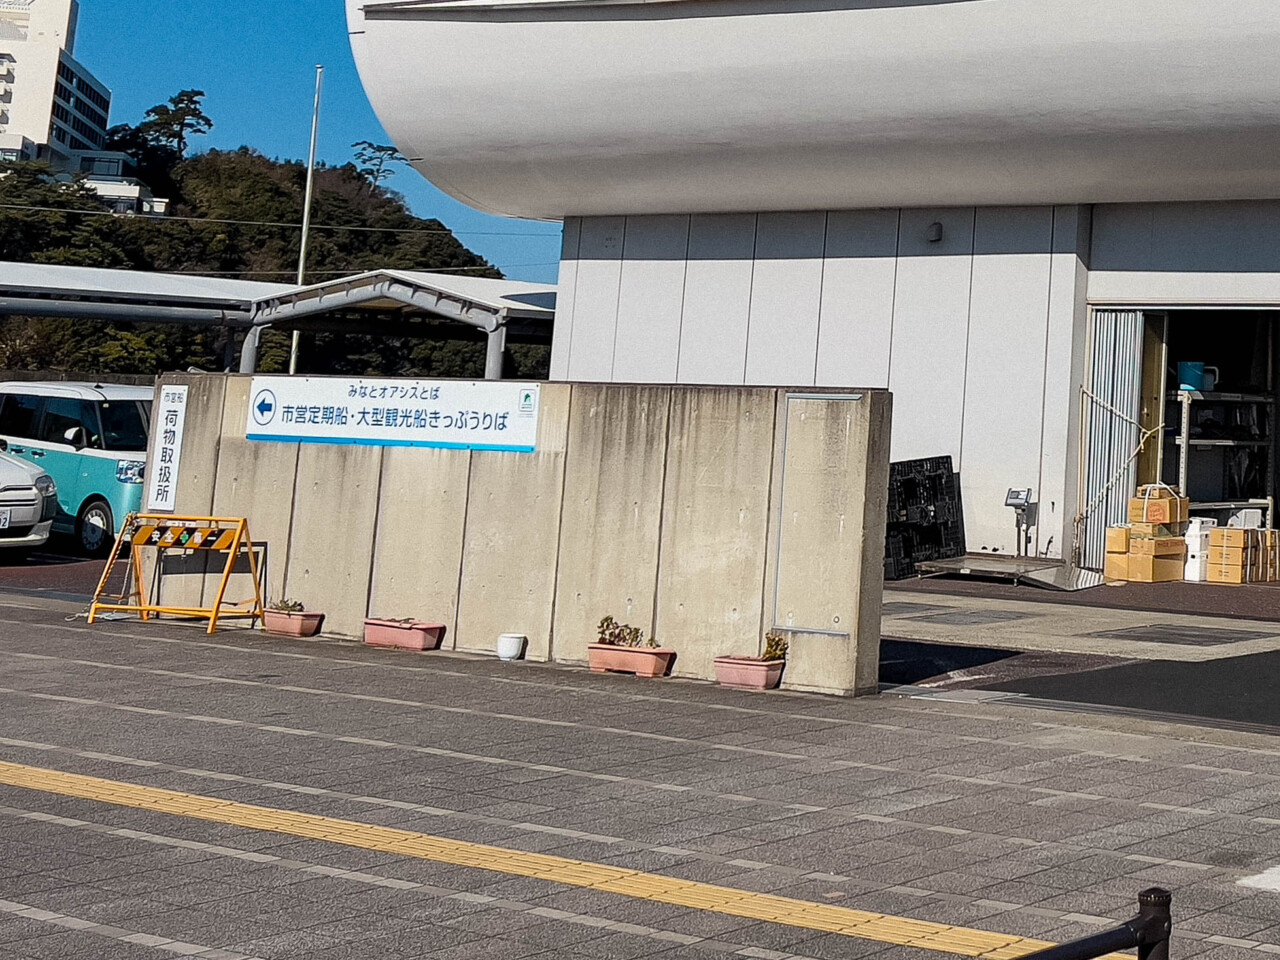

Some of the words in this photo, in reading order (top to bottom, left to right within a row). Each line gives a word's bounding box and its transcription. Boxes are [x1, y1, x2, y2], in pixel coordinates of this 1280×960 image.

[348, 384, 441, 401] みなとオアシスとば
[281, 404, 510, 431] 市営定期船・大型観光船きっぷうりば
[155, 409, 179, 503] 荷物取扱所
